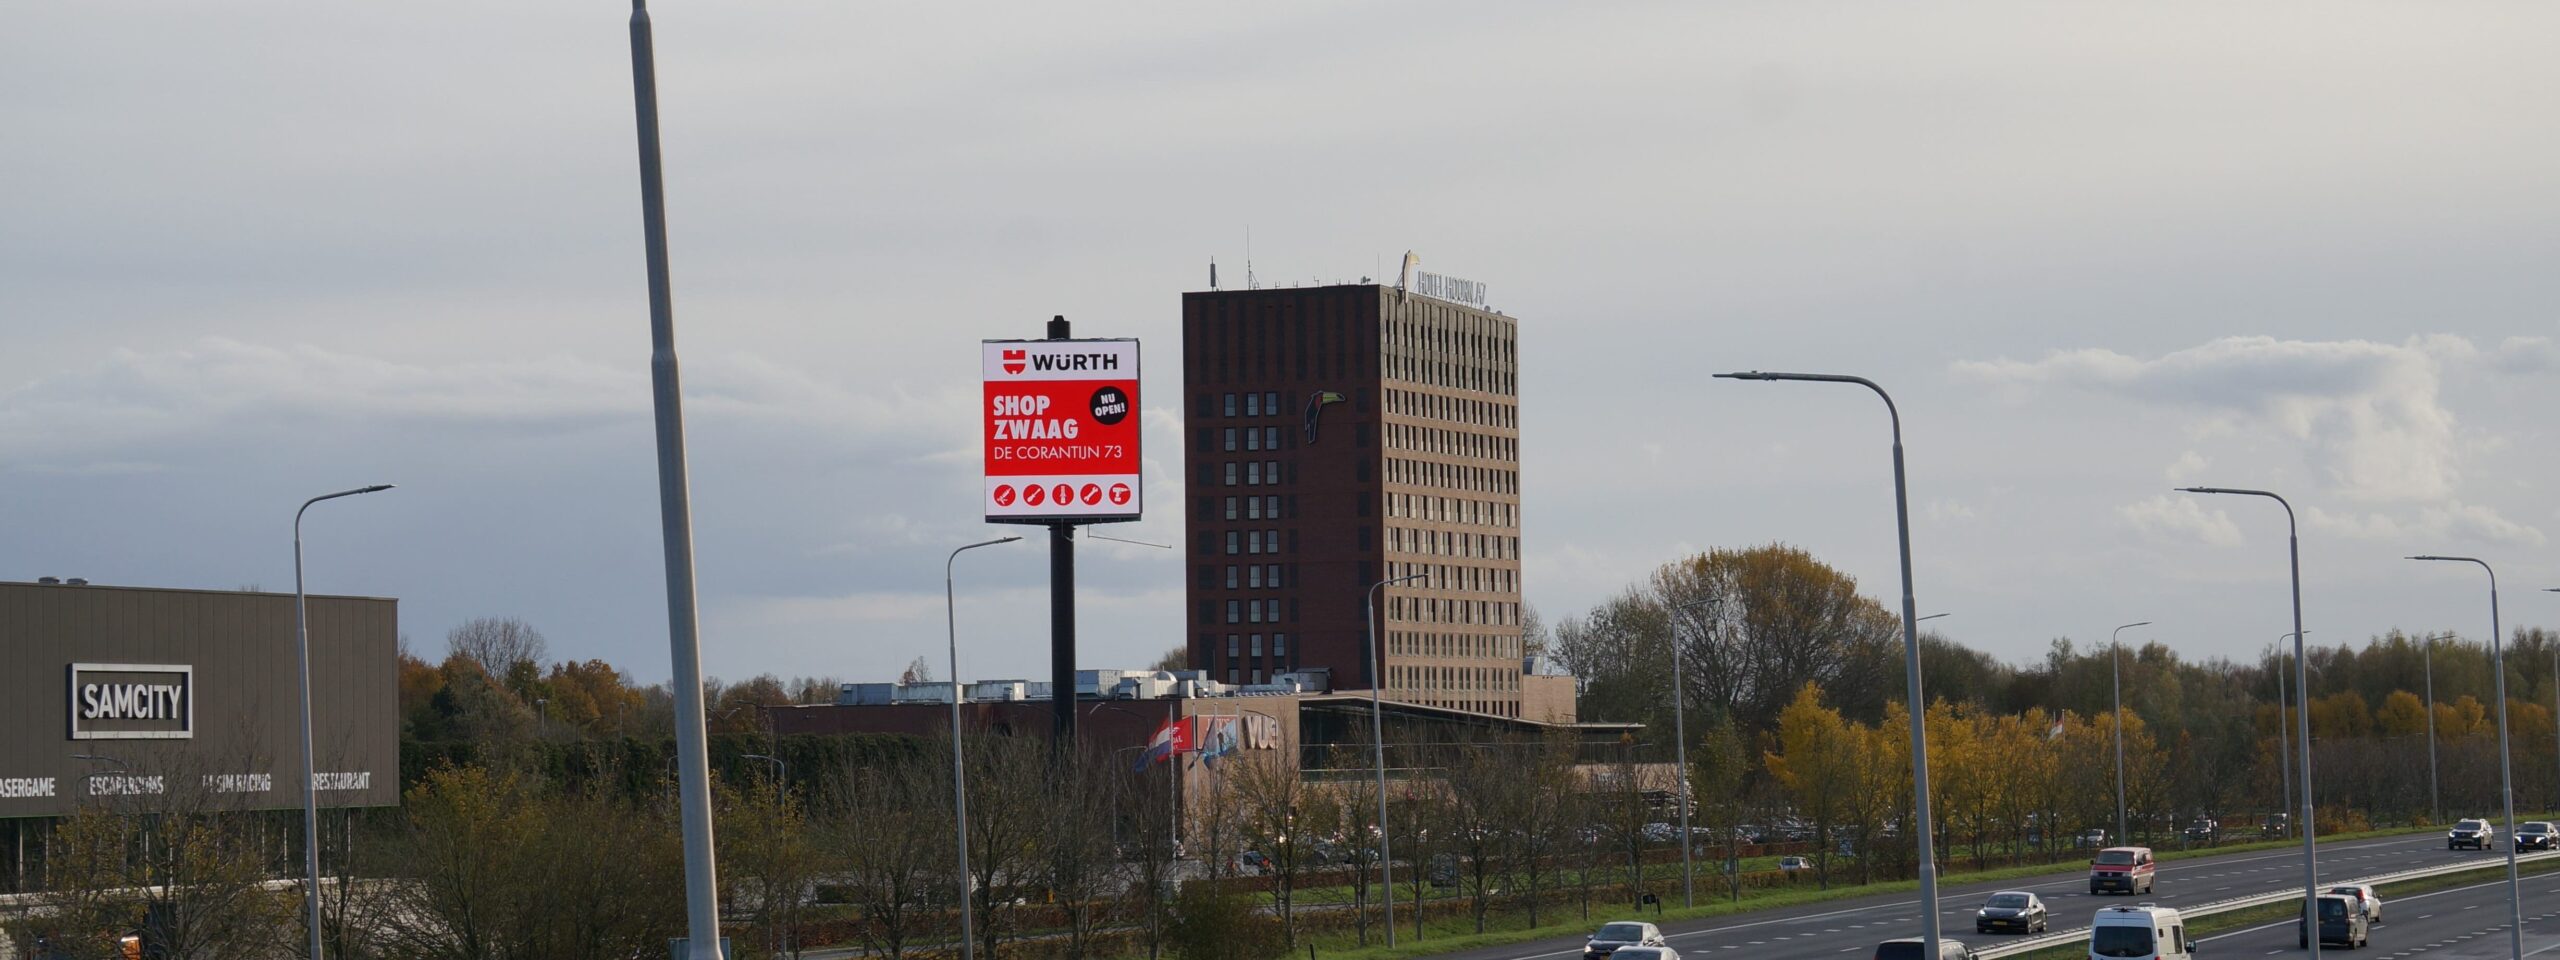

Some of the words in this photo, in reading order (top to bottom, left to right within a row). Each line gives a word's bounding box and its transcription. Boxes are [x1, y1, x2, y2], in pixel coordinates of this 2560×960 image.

[1032, 353, 1118, 371] WÜRTH
[993, 395, 1051, 416] SHOP
[1101, 393, 1116, 404] NU
[1095, 402, 1126, 417] OPEN!
[993, 418, 1079, 440] ZWAAG
[994, 446, 1012, 460] DE
[1016, 445, 1100, 460] CORANTIJN
[1104, 445, 1123, 459] 73
[84, 683, 182, 719] SAMCITY
[0, 777, 56, 798] ASERGAME
[236, 773, 272, 792] RACING
[313, 772, 371, 791] RESTAURANT
